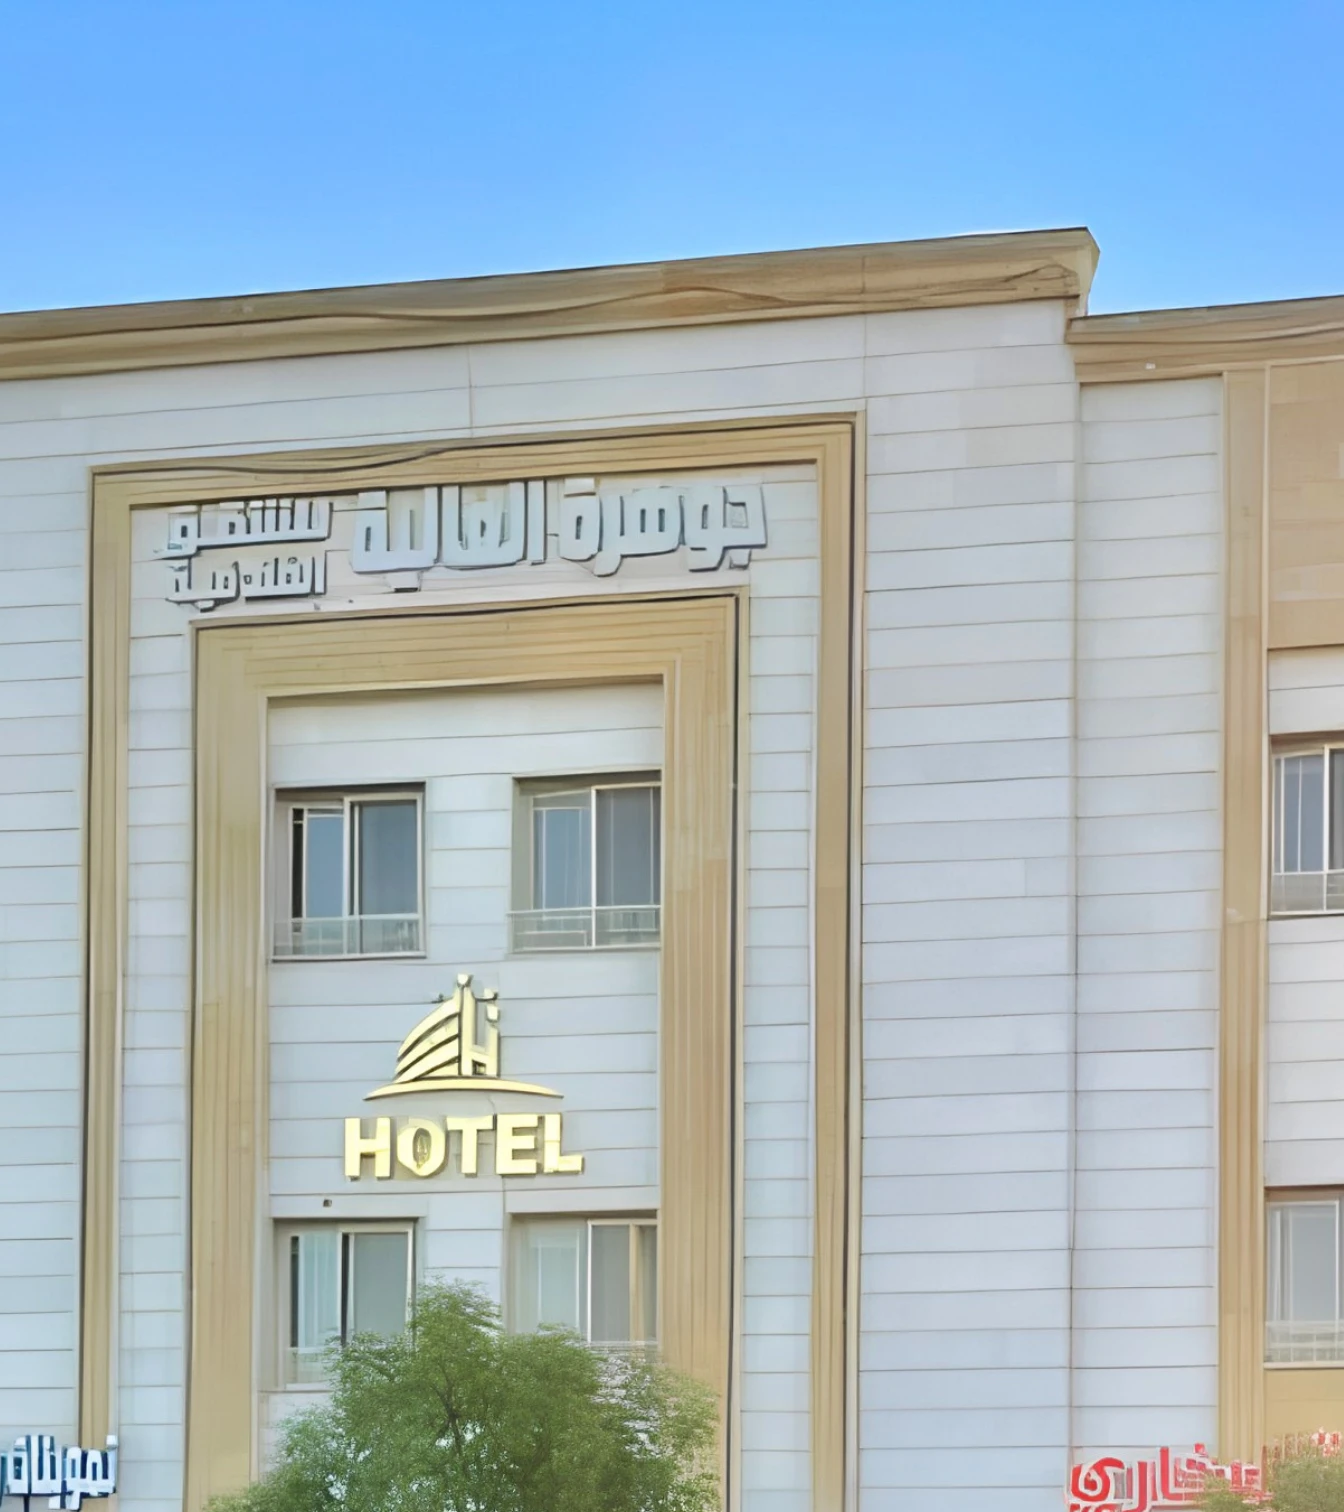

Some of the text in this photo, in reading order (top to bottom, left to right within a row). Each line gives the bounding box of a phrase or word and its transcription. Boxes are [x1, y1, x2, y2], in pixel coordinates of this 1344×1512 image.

[351, 477, 766, 592] جوهرة العالية
[344, 1112, 584, 1178] HOTEL
